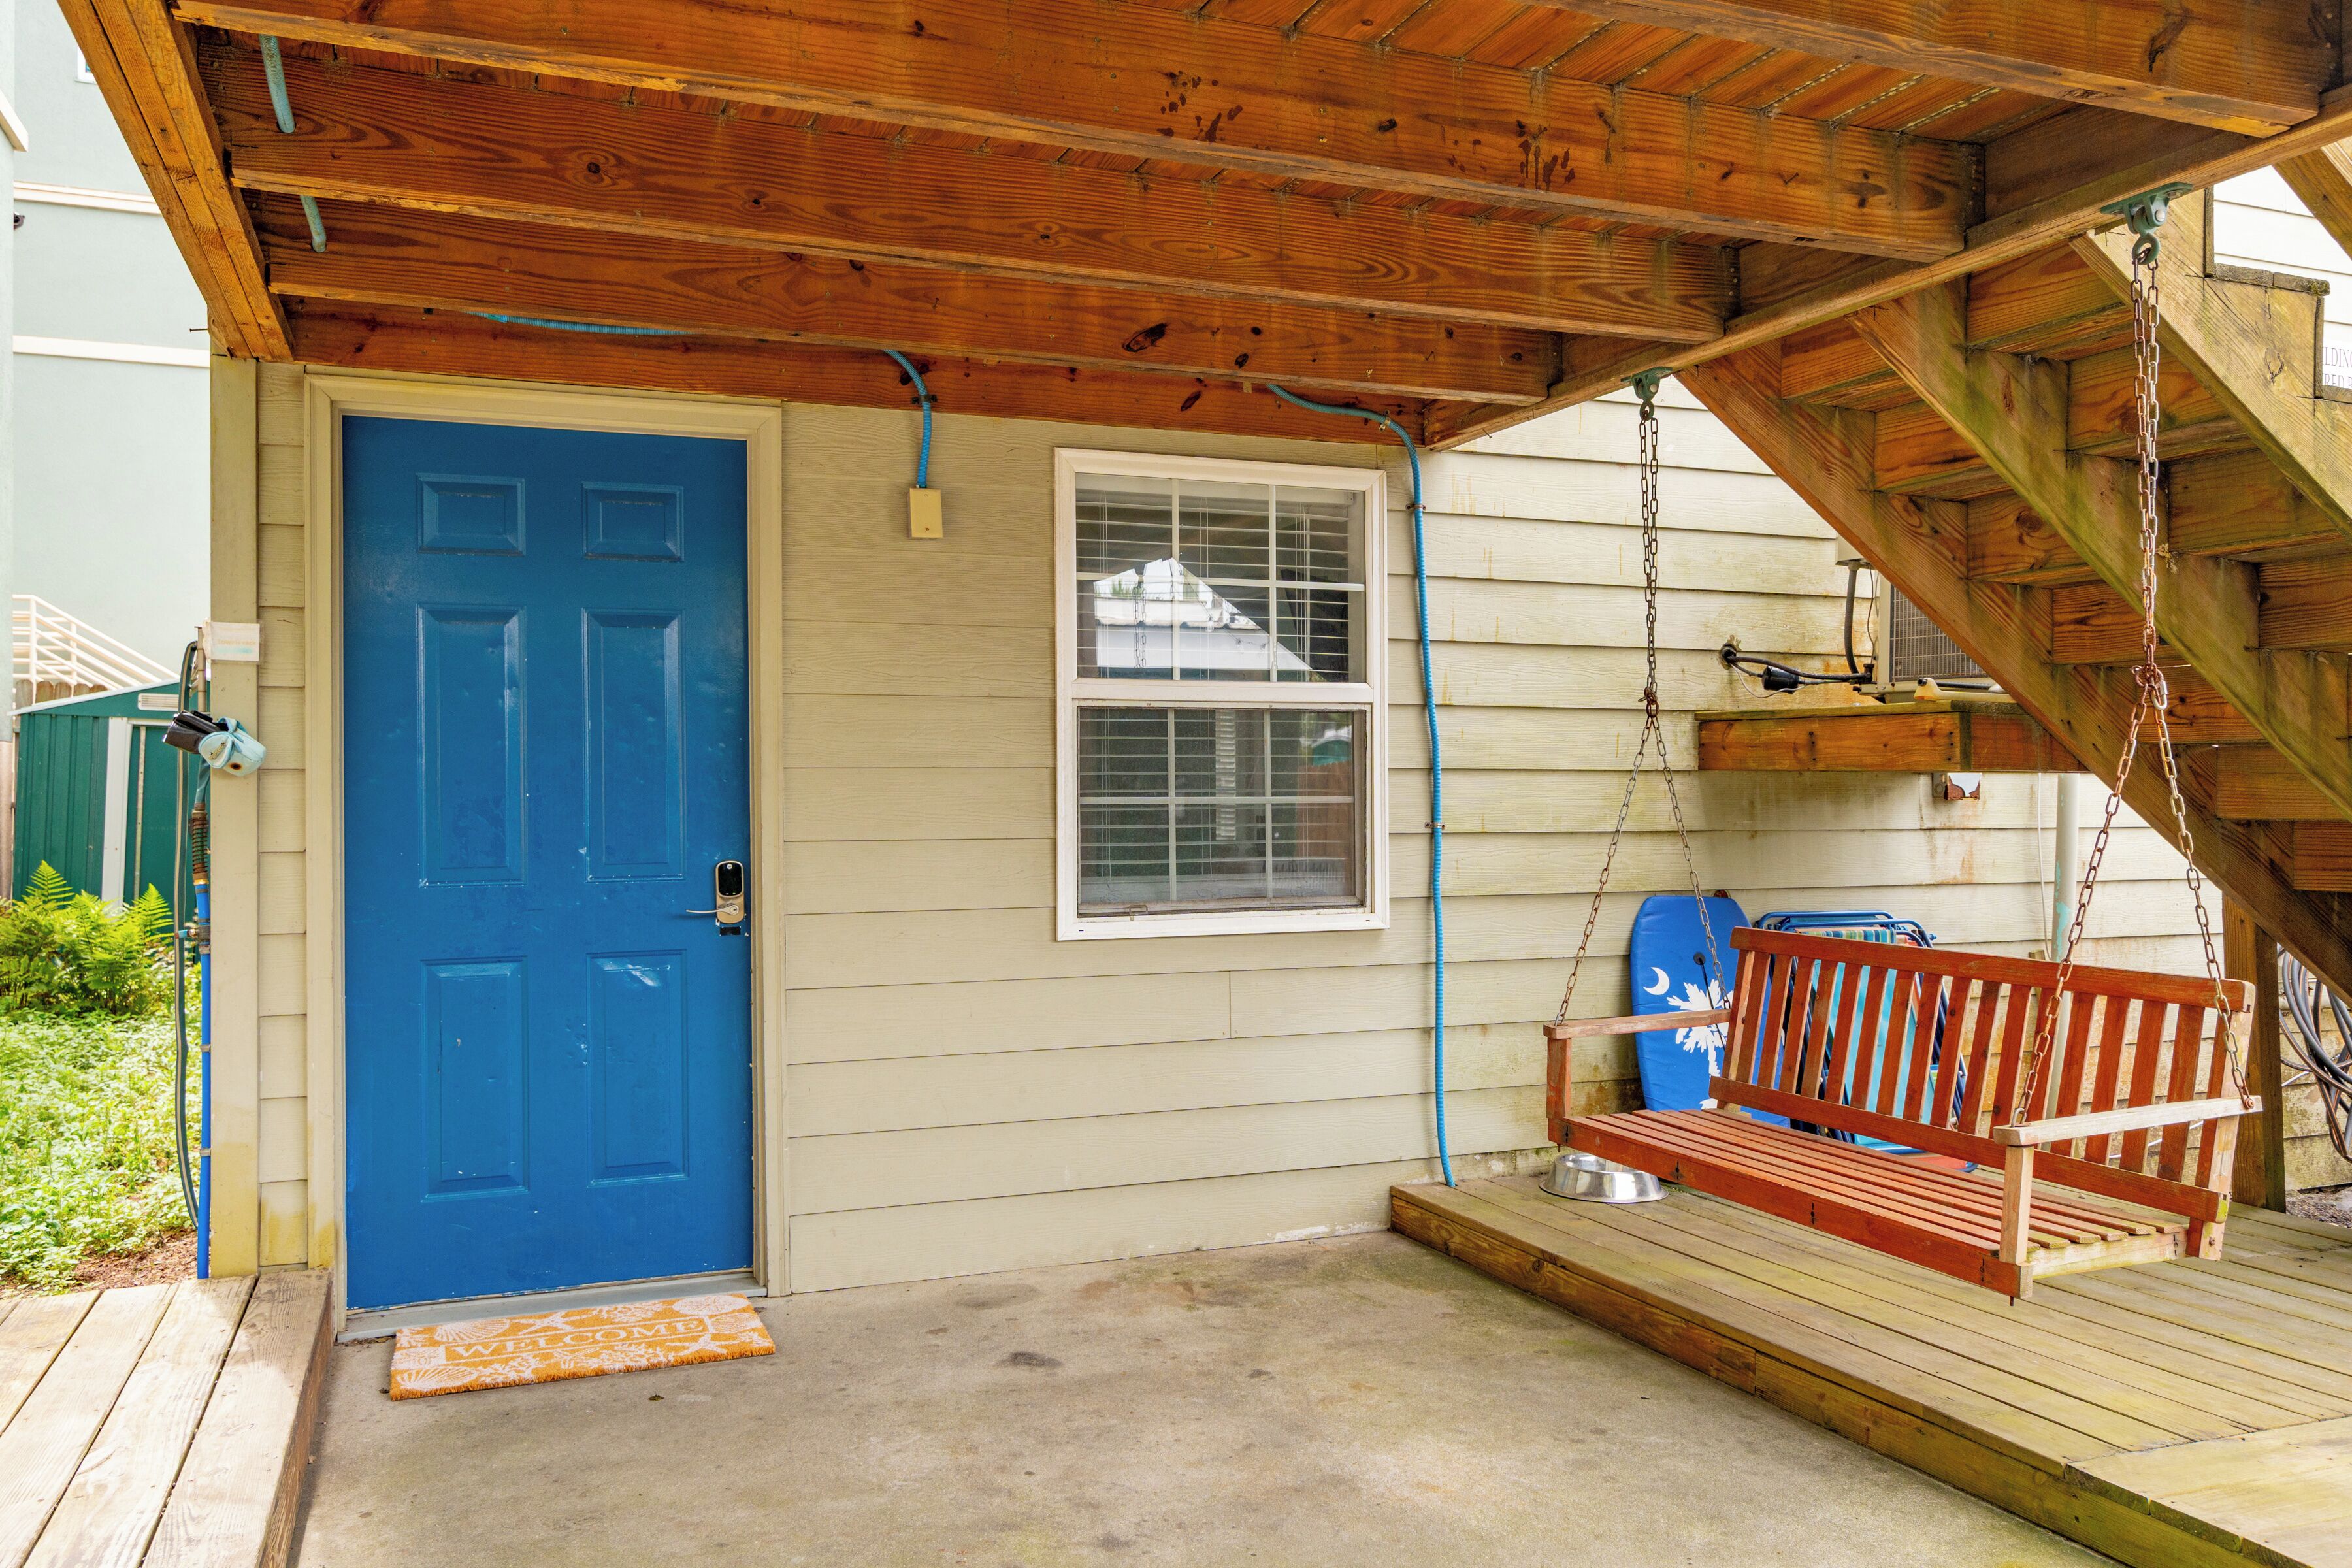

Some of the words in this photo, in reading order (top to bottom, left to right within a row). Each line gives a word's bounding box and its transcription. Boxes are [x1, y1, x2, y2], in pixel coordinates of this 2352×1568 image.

[2323, 346, 2352, 368] LDIN
[2323, 373, 2344, 388] RED
[452, 1321, 703, 1357] WELCOME
